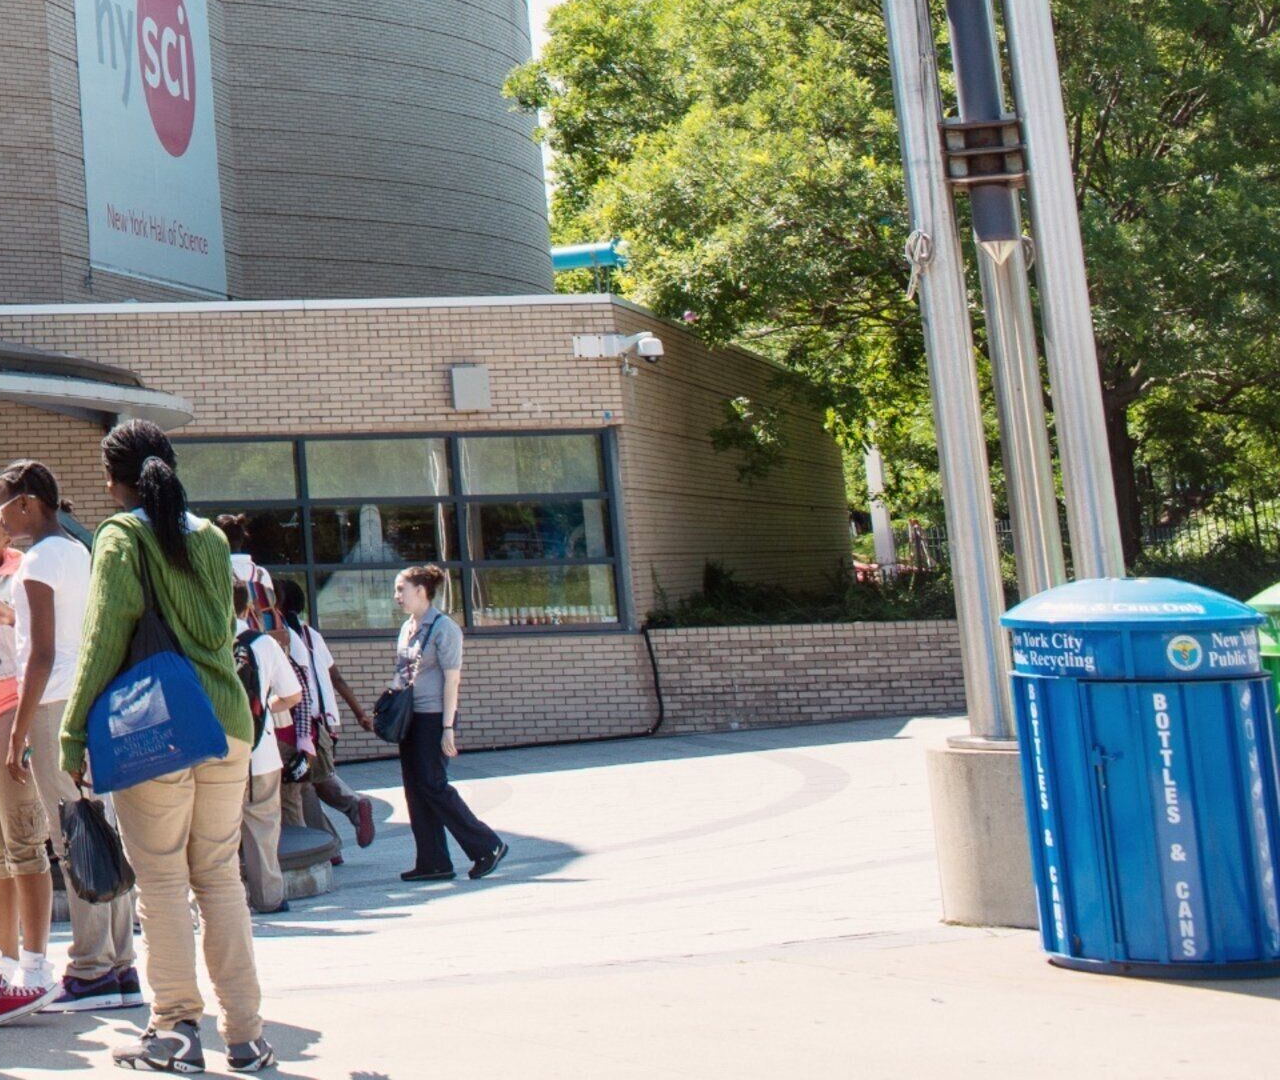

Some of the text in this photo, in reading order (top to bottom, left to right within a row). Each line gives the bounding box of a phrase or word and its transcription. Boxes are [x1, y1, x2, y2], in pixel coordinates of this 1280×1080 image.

[106, 202, 209, 256] New York Hall of Science
[1162, 602, 1206, 614] Only
[1022, 632, 1049, 649] York
[1051, 632, 1083, 653] City
[1211, 632, 1240, 649] New
[1029, 650, 1095, 672] Recycling
[1208, 649, 1246, 668] Public
[1028, 683, 1064, 940] BOTTLES & CANS
[1152, 692, 1197, 957] BOTTLES & CANS
